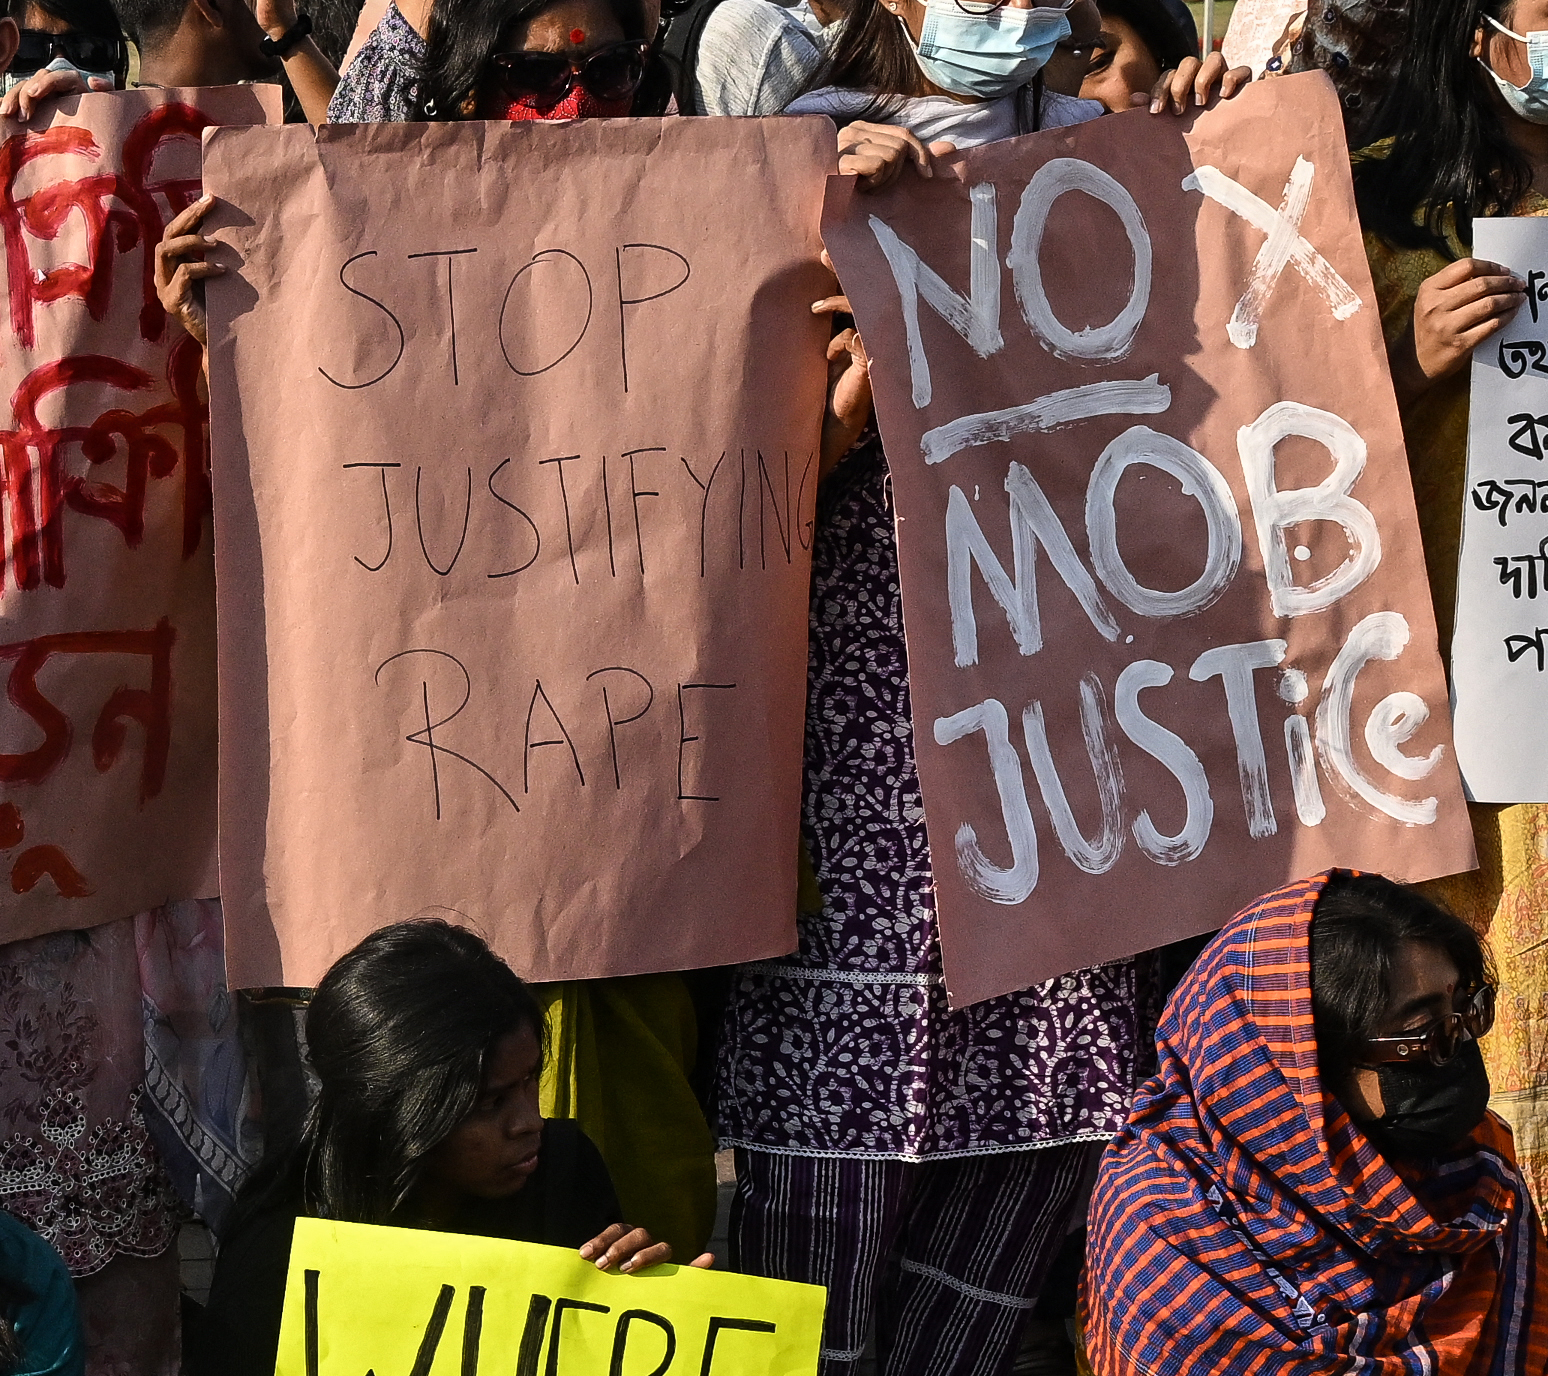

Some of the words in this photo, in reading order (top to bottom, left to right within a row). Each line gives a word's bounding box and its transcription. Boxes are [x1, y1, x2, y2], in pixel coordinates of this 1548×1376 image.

[317, 244, 692, 393] STOP
[868, 157, 1152, 409] NO
[342, 447, 814, 586] JUSTIFYING
[945, 400, 1382, 669] MOB
[374, 647, 738, 821] RAPE
